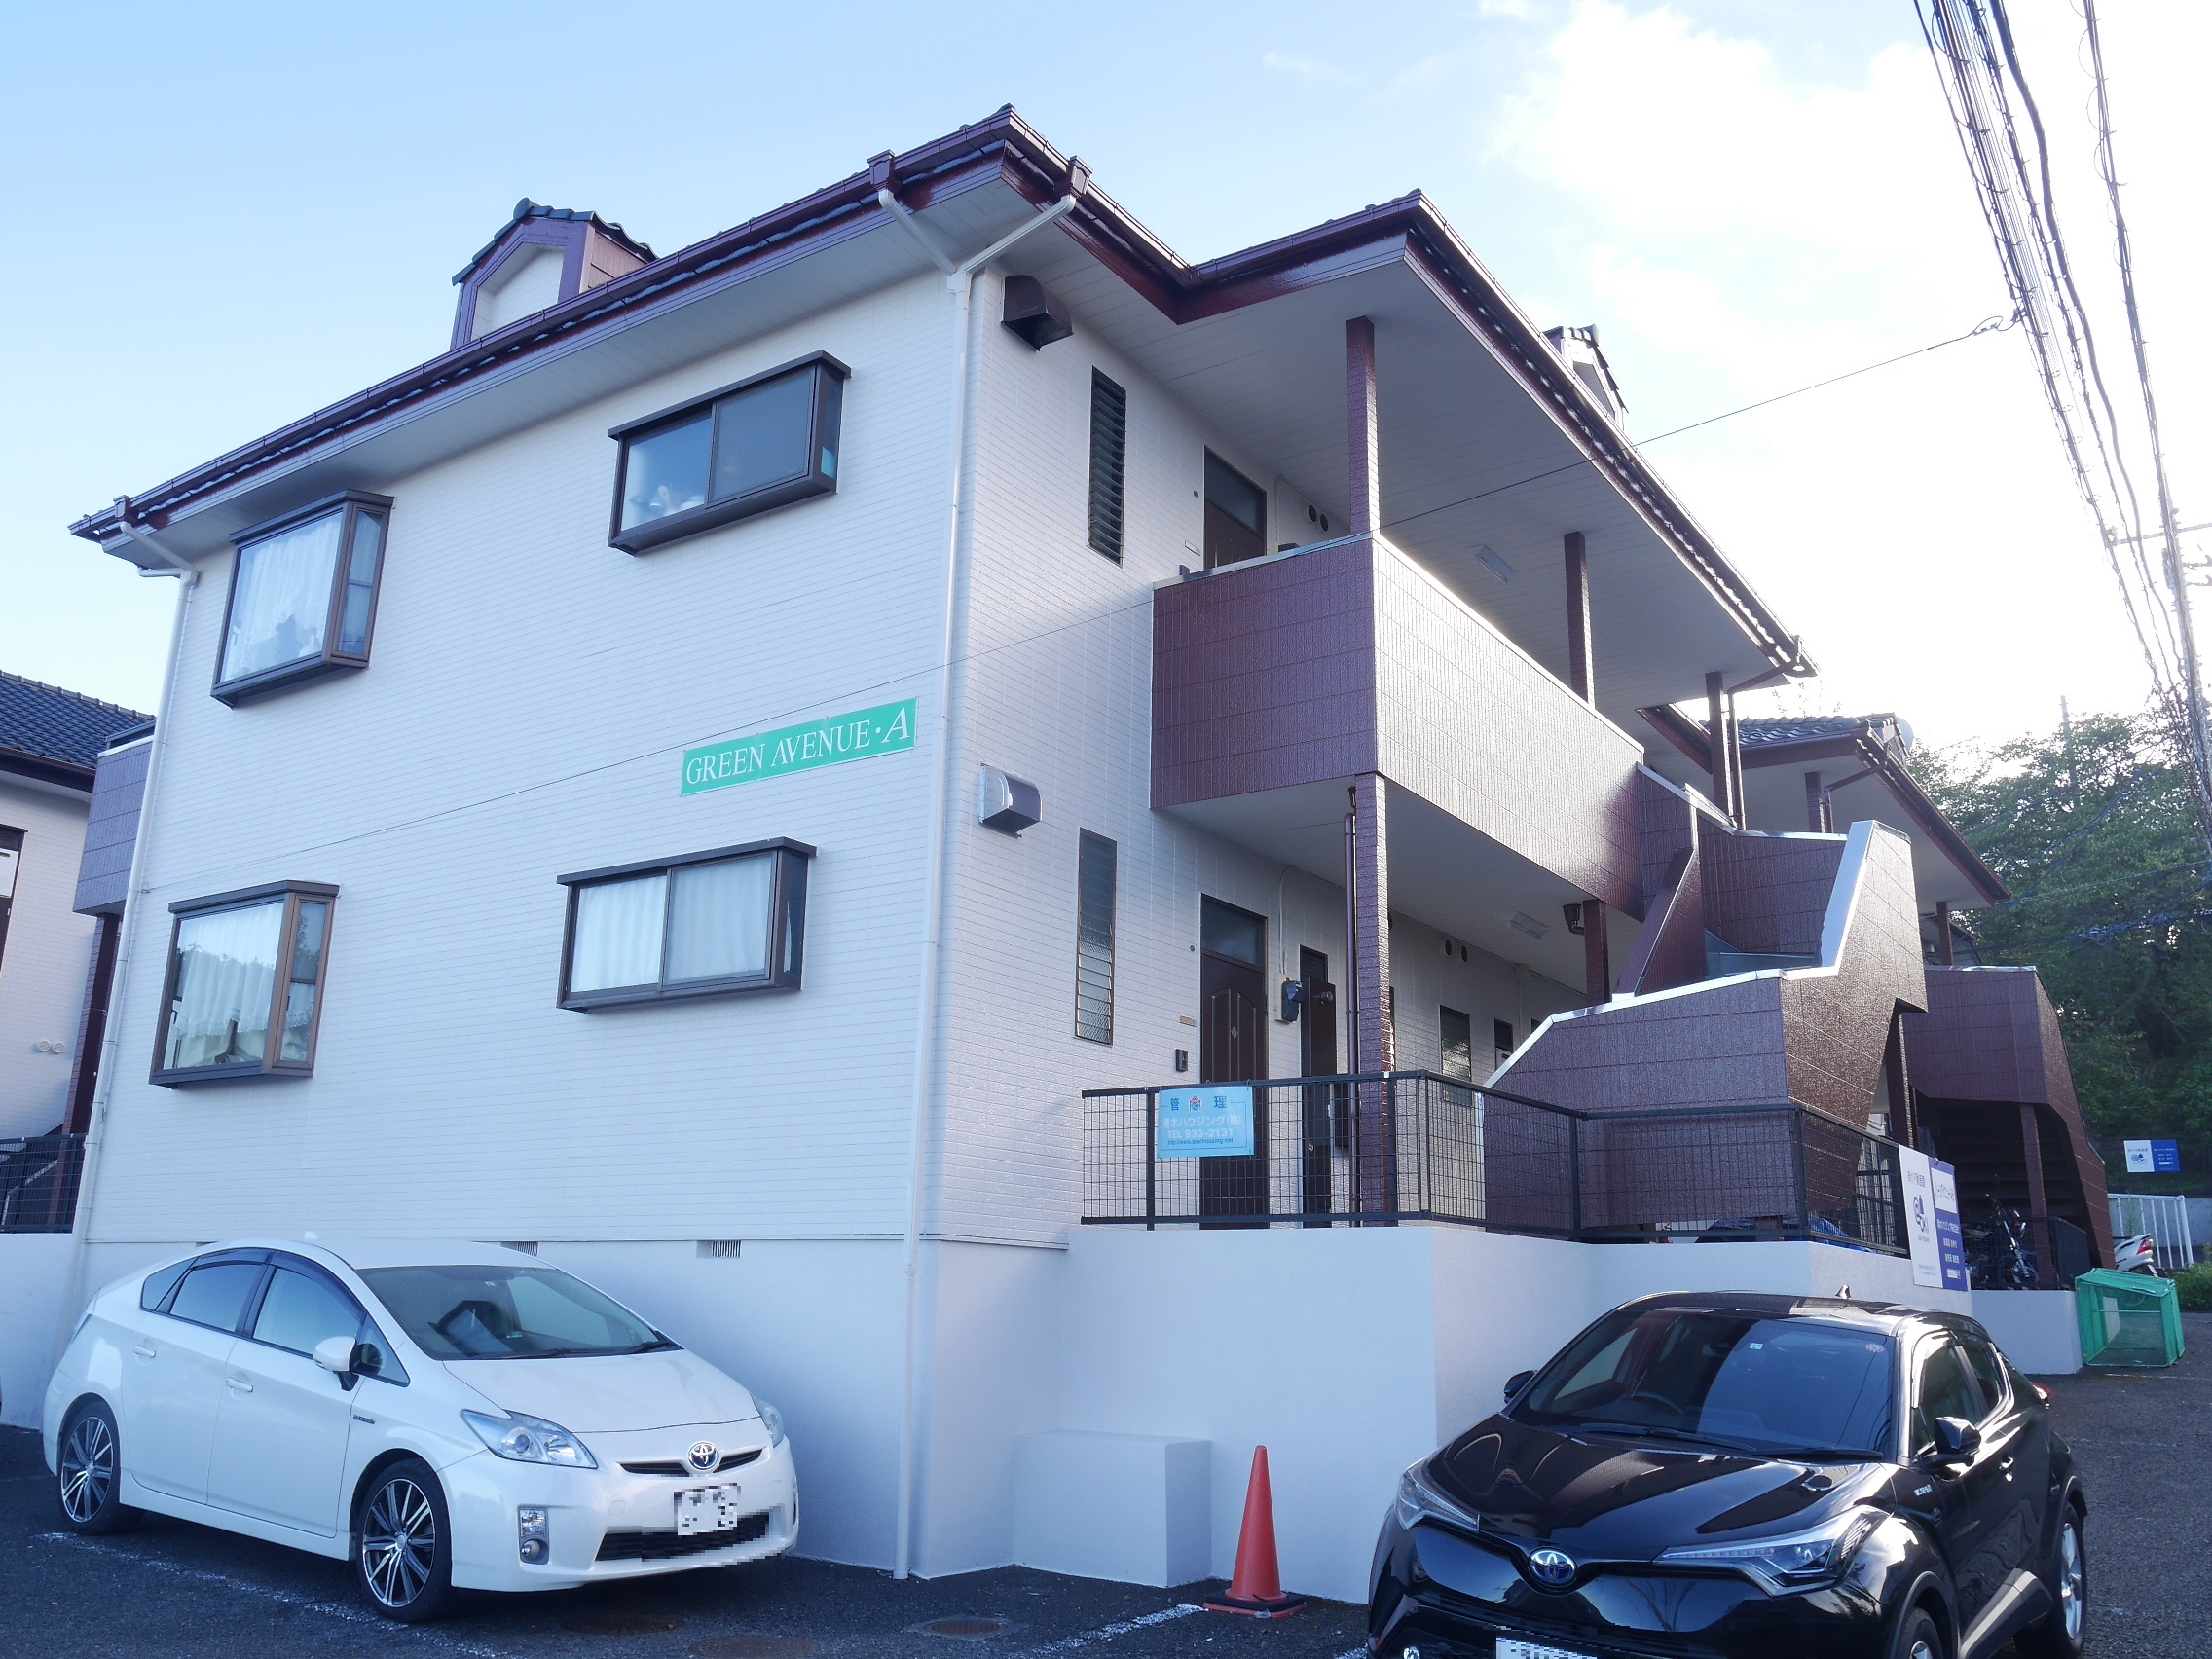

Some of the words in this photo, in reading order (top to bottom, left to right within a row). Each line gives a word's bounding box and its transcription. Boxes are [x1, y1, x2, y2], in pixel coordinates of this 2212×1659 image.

[686, 743, 766, 785] GREEN
[1170, 1097, 1180, 1111] 管
[1213, 1095, 1228, 1109] 理
[1167, 1130, 1183, 1139] TEL
[1184, 1128, 1234, 1139] 933-2131
